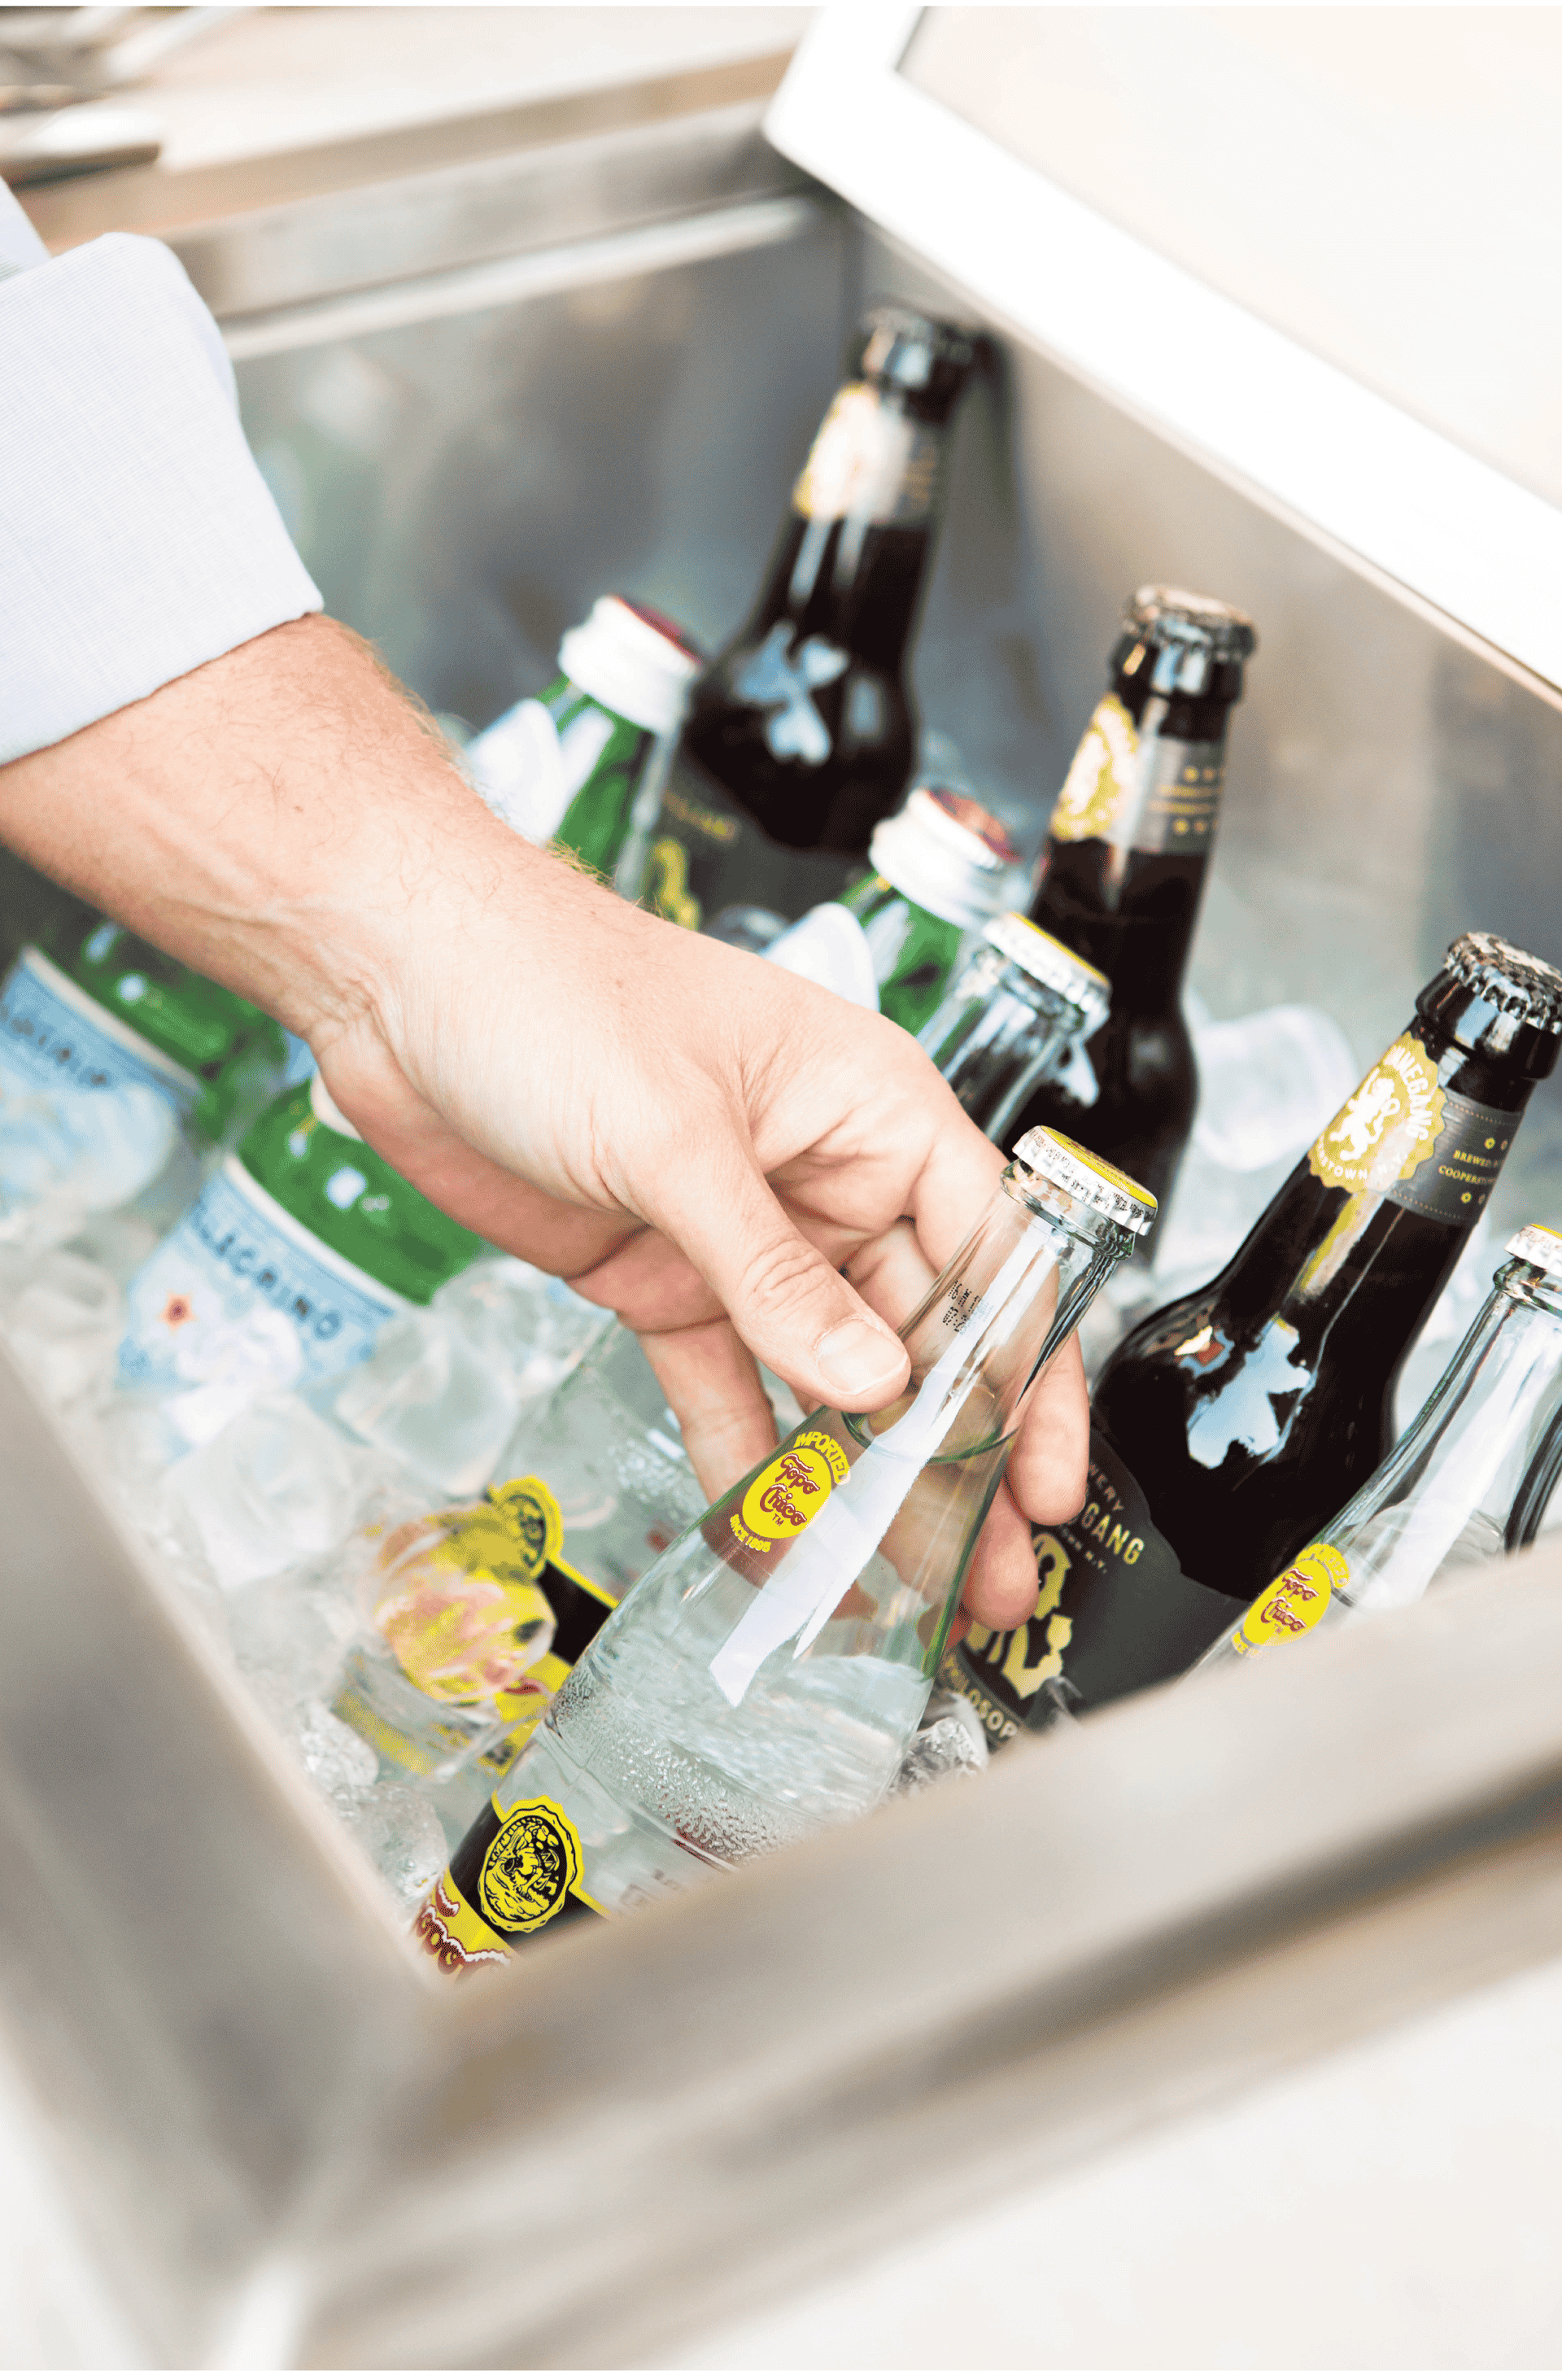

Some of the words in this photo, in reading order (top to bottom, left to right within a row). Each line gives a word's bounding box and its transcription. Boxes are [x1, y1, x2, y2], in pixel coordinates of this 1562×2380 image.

[774, 1452, 821, 1496] Topo
[792, 1430, 852, 1486] IMPORTED
[759, 1483, 808, 1527] Chico
[1088, 1462, 1124, 1510] WERY
[772, 1513, 785, 1527] TM
[1080, 1502, 1145, 1566] GANG
[1275, 1567, 1320, 1602] Topo
[1260, 1596, 1307, 1633] Chico
